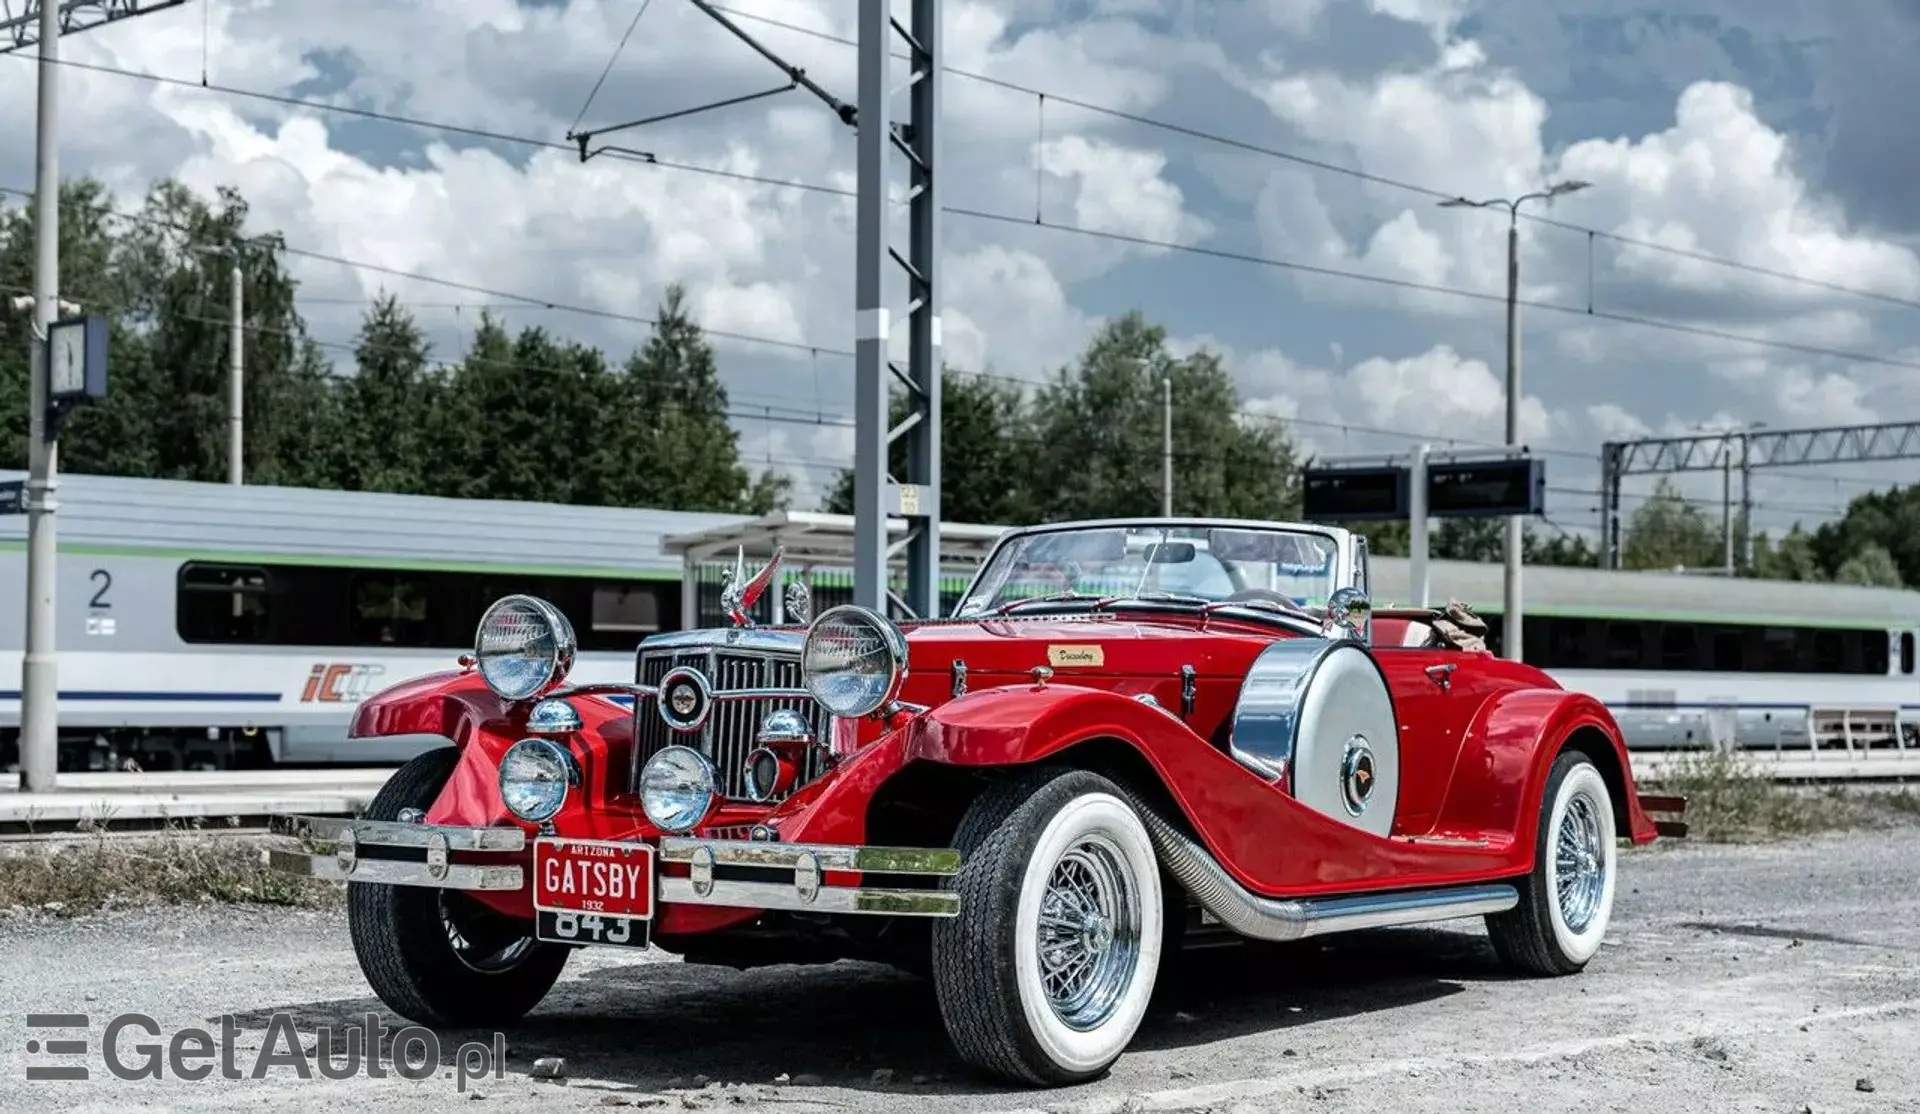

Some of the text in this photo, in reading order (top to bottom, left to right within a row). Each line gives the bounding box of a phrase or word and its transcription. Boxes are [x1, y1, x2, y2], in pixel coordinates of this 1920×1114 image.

[89, 569, 112, 608] 2
[571, 845, 616, 858] ARIZONA
[545, 858, 640, 900] GATSBY
[582, 900, 604, 912] 1932
